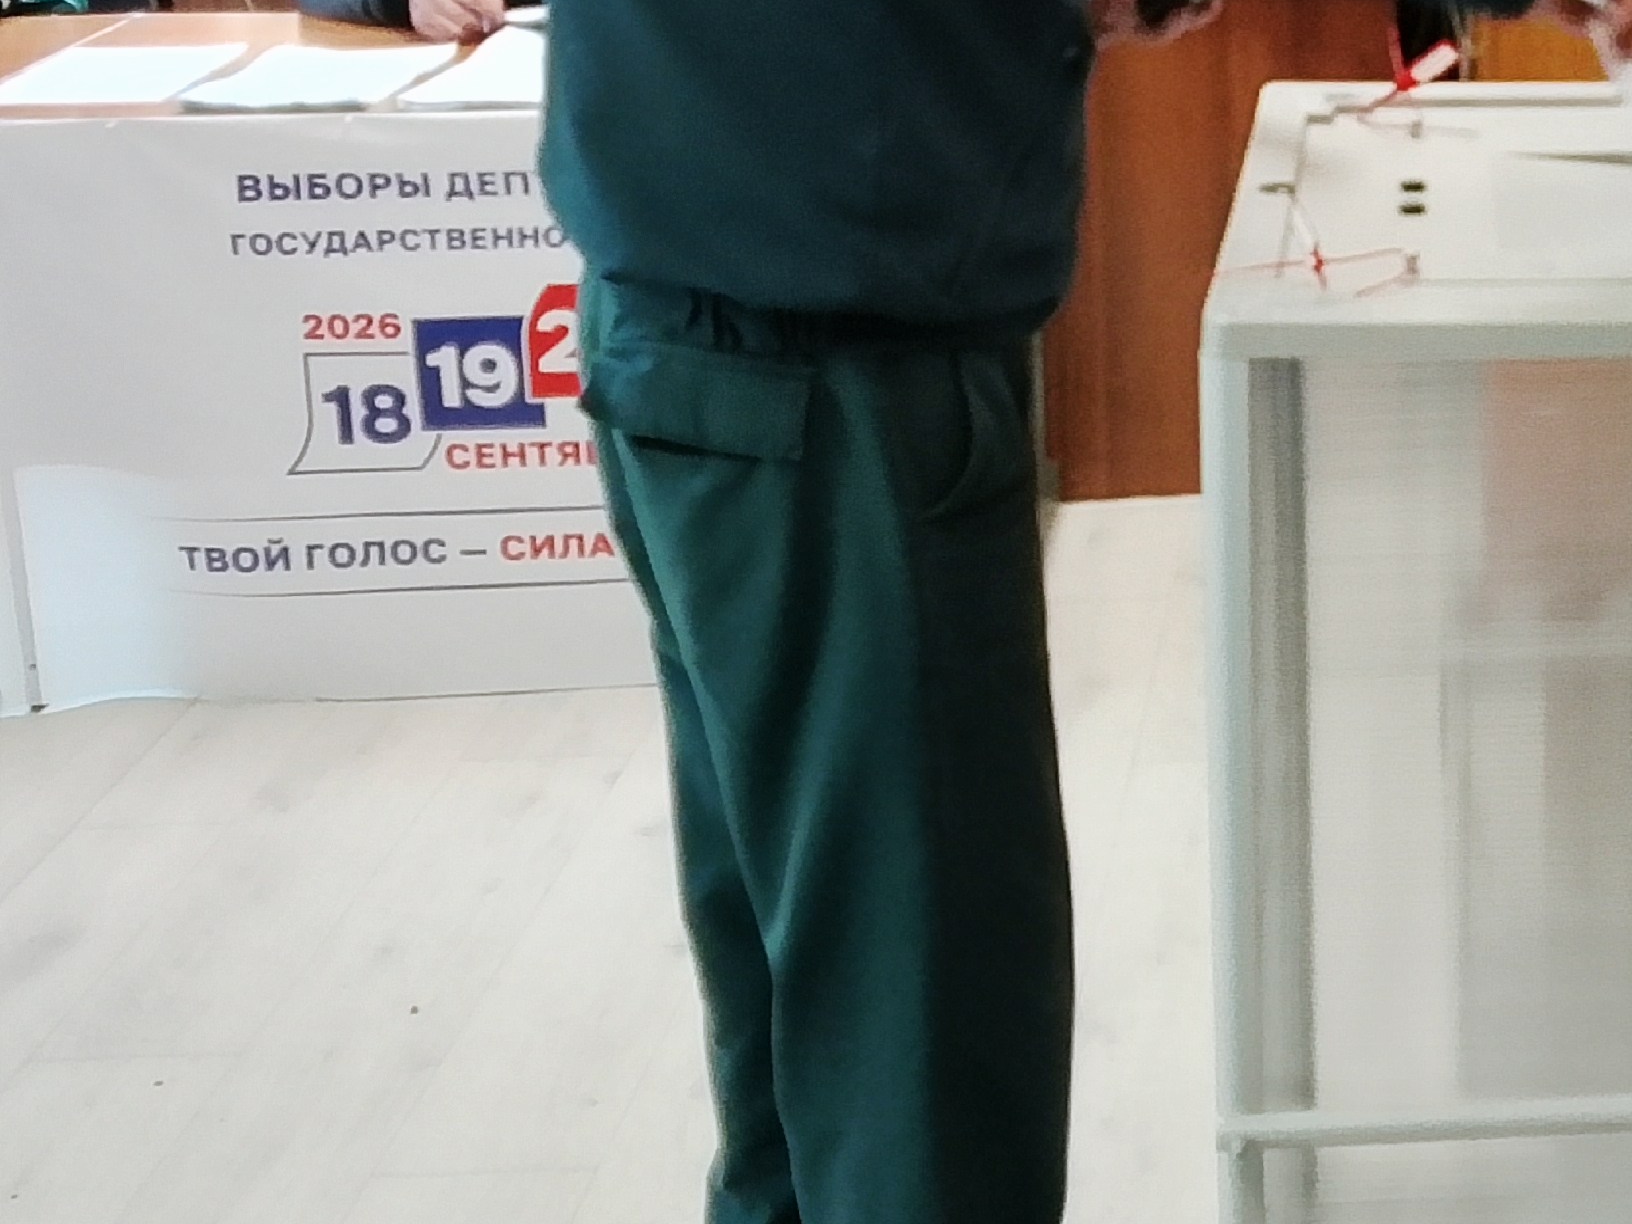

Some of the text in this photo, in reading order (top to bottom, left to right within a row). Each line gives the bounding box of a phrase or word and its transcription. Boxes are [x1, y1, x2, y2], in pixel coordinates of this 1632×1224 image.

[237, 171, 530, 203] ВЫБОРЫ ДЕП
[229, 227, 565, 258] ГОСУДАРСТВЕННО
[302, 313, 401, 340] 2026
[321, 384, 412, 444] 18
[425, 343, 518, 409] 19
[178, 536, 291, 572] ТВОЙ
[305, 537, 446, 571] ГОЛОС
[500, 532, 615, 561] СИЛА
